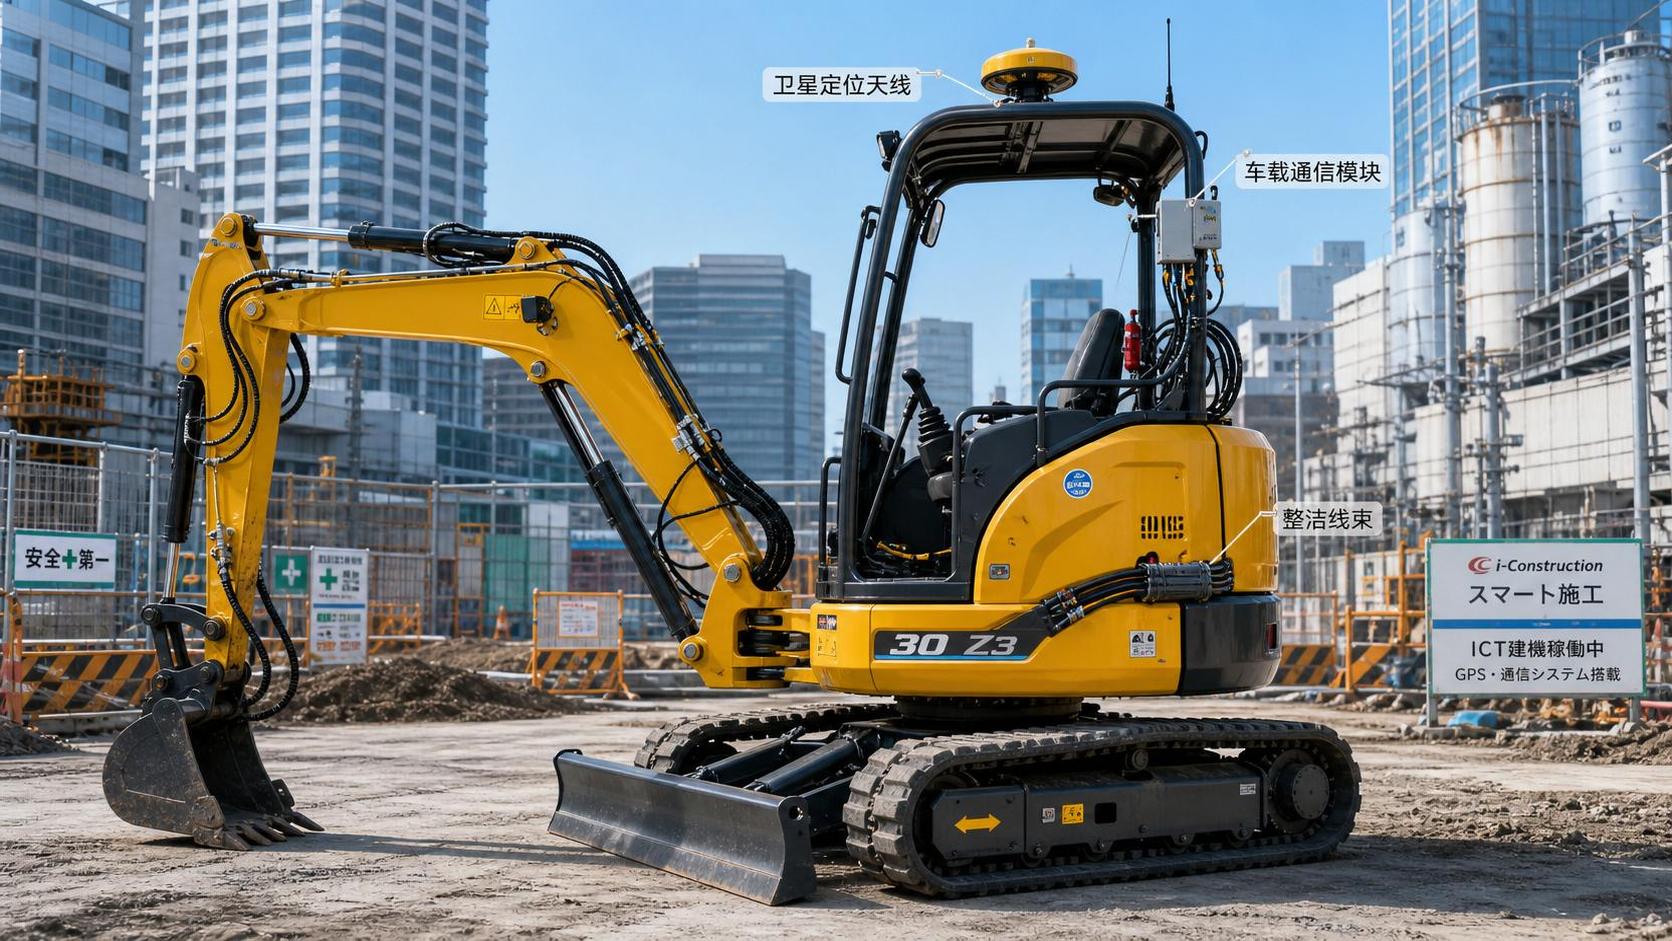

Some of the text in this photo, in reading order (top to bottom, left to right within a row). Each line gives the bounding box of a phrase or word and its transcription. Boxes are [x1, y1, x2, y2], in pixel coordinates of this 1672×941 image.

[1496, 558, 1603, 573] i-Construction
[1469, 583, 1604, 605] スマート施工
[889, 633, 1018, 655] 30 Z3
[1471, 639, 1604, 658] ICT建機稼働中
[1455, 667, 1621, 682] GPS・通信システム搭載
